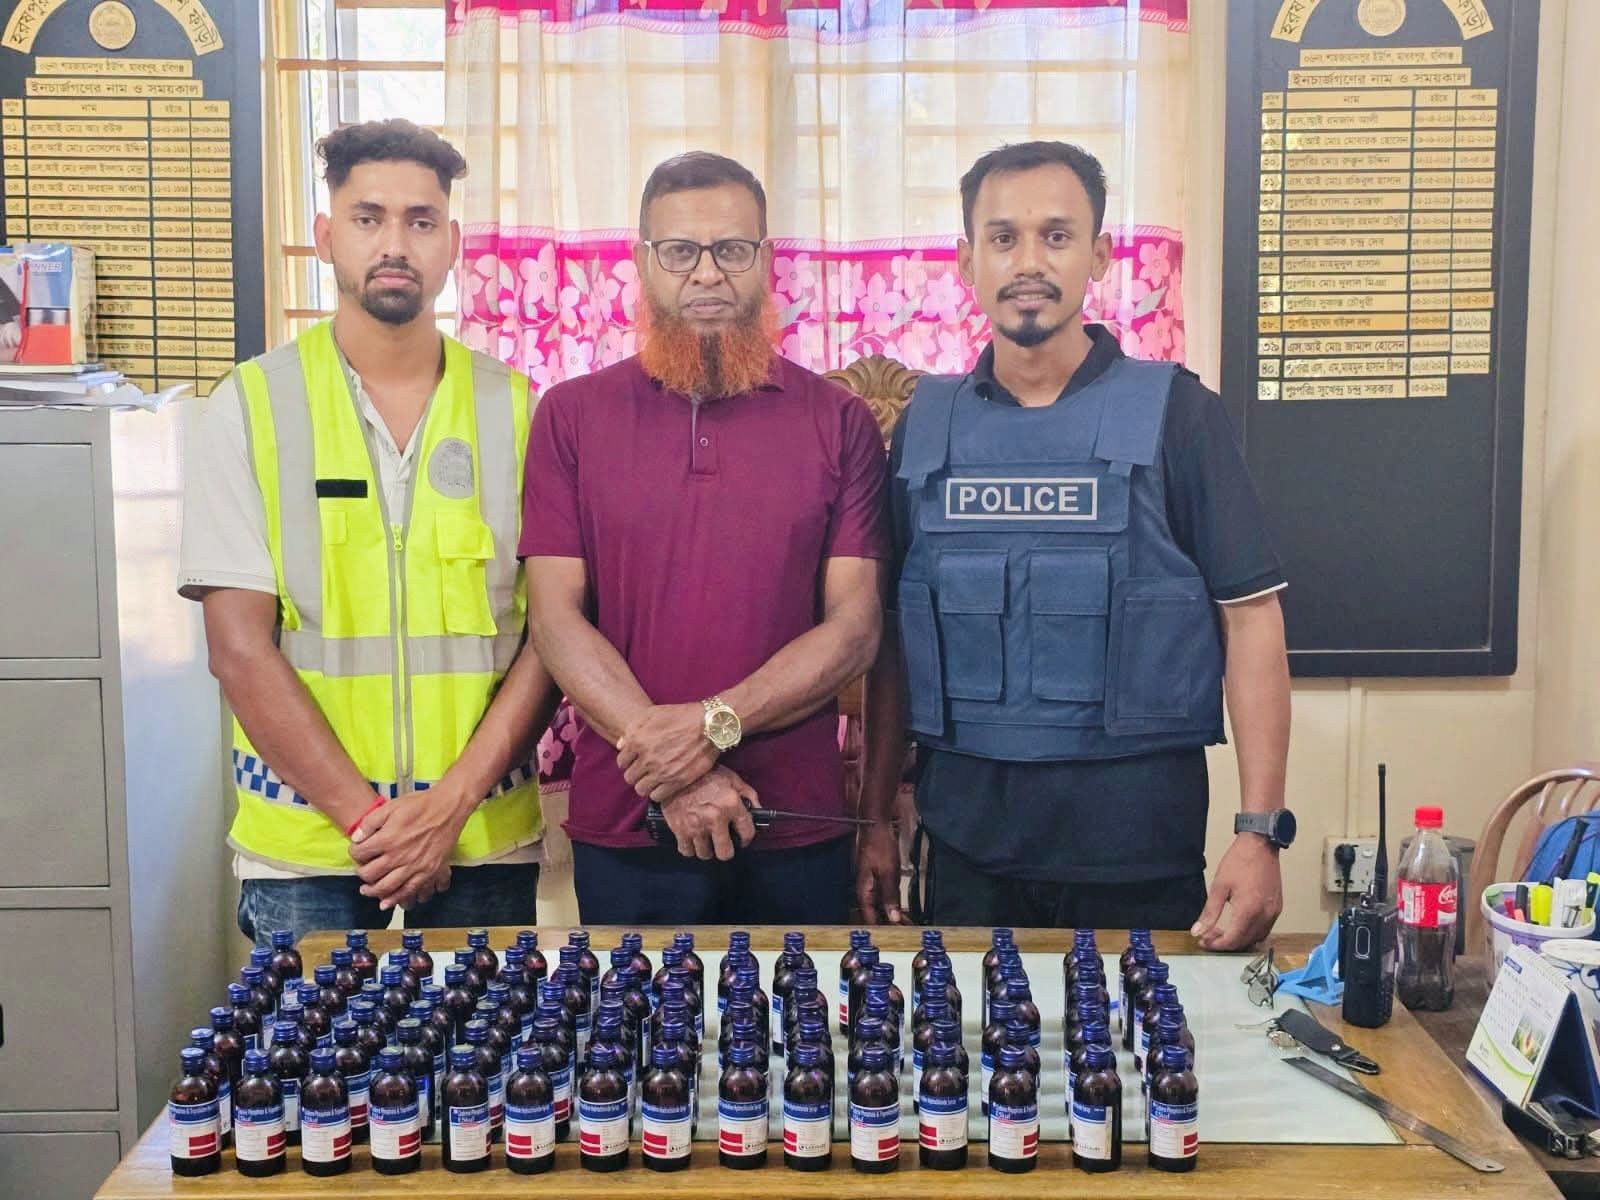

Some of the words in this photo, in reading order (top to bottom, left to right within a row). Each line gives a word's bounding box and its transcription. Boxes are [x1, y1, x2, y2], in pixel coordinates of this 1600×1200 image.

[1370, 74, 1393, 85] নাম
[1400, 74, 1409, 83] ও
[106, 84, 128, 94] নাম
[135, 85, 143, 94] ও
[959, 486, 1079, 512] POLICE
